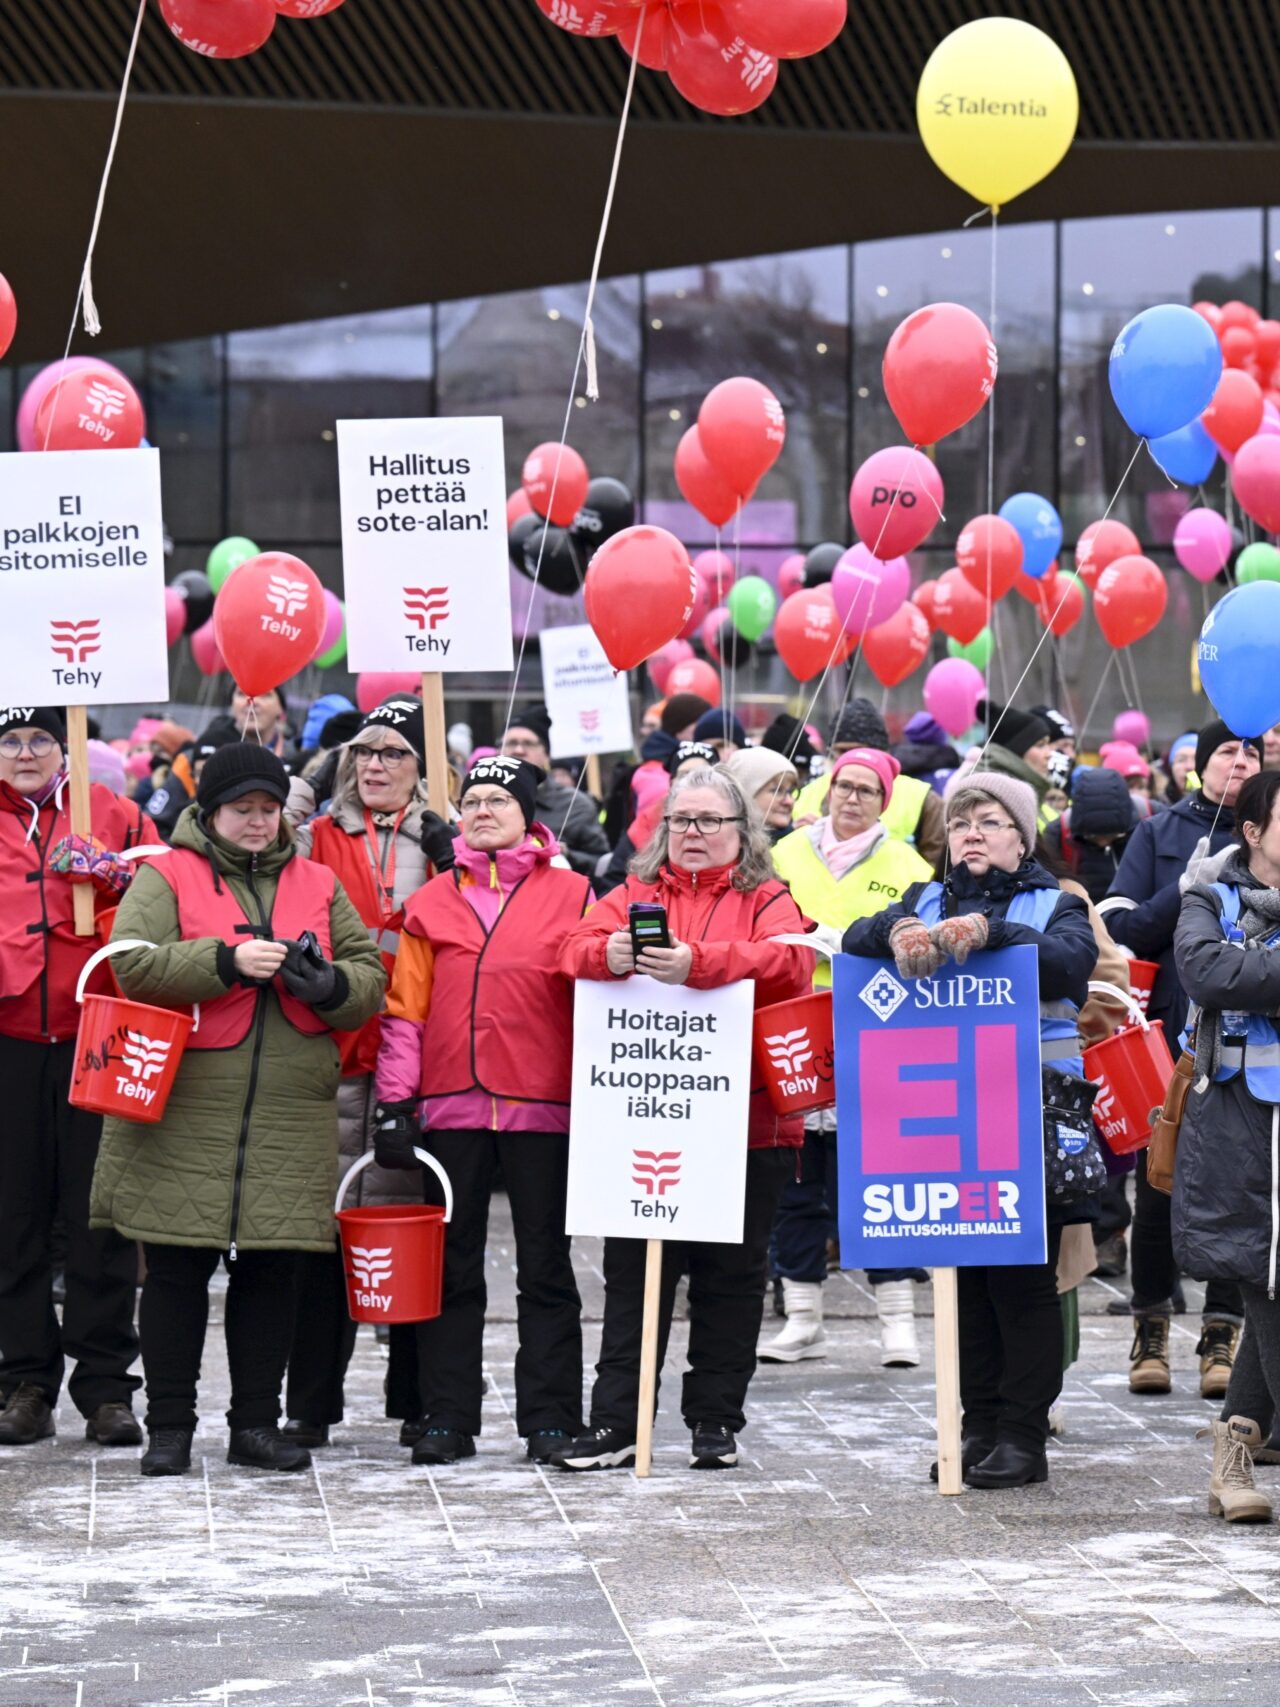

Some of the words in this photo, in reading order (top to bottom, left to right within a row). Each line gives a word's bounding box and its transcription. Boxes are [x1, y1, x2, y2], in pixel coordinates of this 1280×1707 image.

[720, 36, 745, 63] ehy
[957, 96, 1047, 118] Talentia
[78, 414, 115, 442] Tehy
[369, 454, 471, 476] Hallitus
[59, 496, 82, 516] EI
[376, 482, 467, 508] pettää
[870, 486, 917, 509] pro
[357, 508, 489, 533] sote-alan!
[4, 521, 140, 550] palkkojen
[0, 545, 148, 570] sitomiselle
[260, 615, 302, 641] Tehy
[405, 635, 451, 656] Tehy
[1198, 641, 1218, 662] PER
[53, 668, 102, 689] Tehy
[868, 880, 898, 898] pro
[607, 1008, 717, 1037] Hoitajat
[611, 1038, 712, 1063] palkka-
[116, 1075, 156, 1106] Tehy
[590, 1065, 730, 1095] kuoppaan
[777, 1076, 818, 1097] Tehy
[627, 1096, 692, 1119] iäksi
[859, 1024, 1019, 1175] EI
[631, 1200, 679, 1223] Tehy
[863, 1181, 1020, 1223] SUPER
[863, 1221, 1021, 1239] HALLITUSOHJELMALLE
[354, 1290, 392, 1312] Tehy
